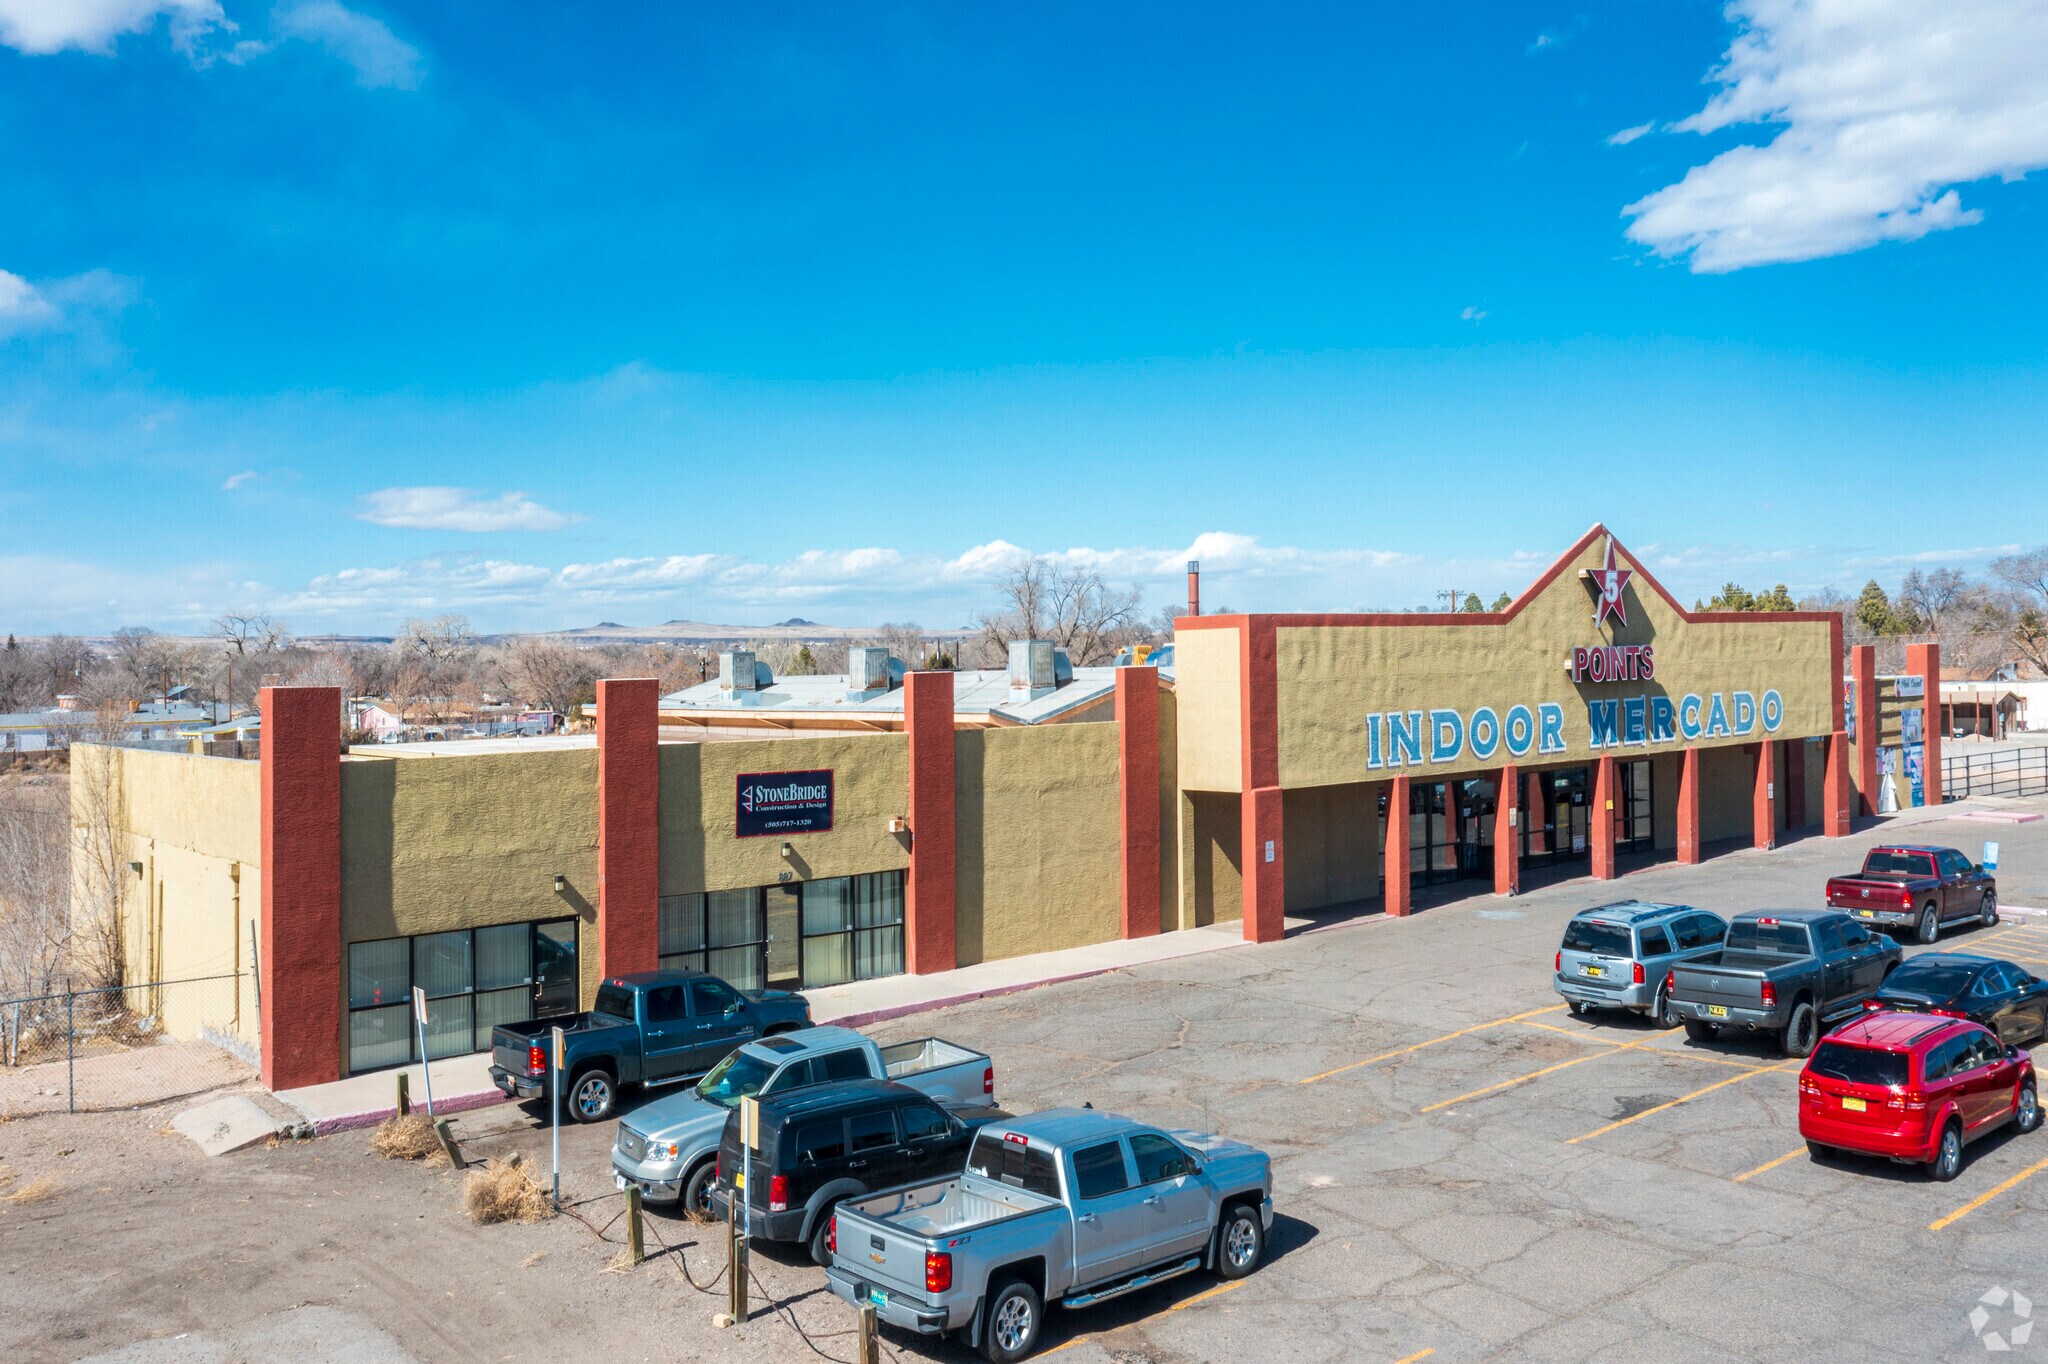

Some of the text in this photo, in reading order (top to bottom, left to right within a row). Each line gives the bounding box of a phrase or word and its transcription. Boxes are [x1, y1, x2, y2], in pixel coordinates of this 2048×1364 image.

[1604, 570, 1619, 604] 5
[1571, 645, 1654, 683] POINTS
[1366, 688, 1784, 769] INDOOR MERCADO
[755, 804, 797, 812] Construction
